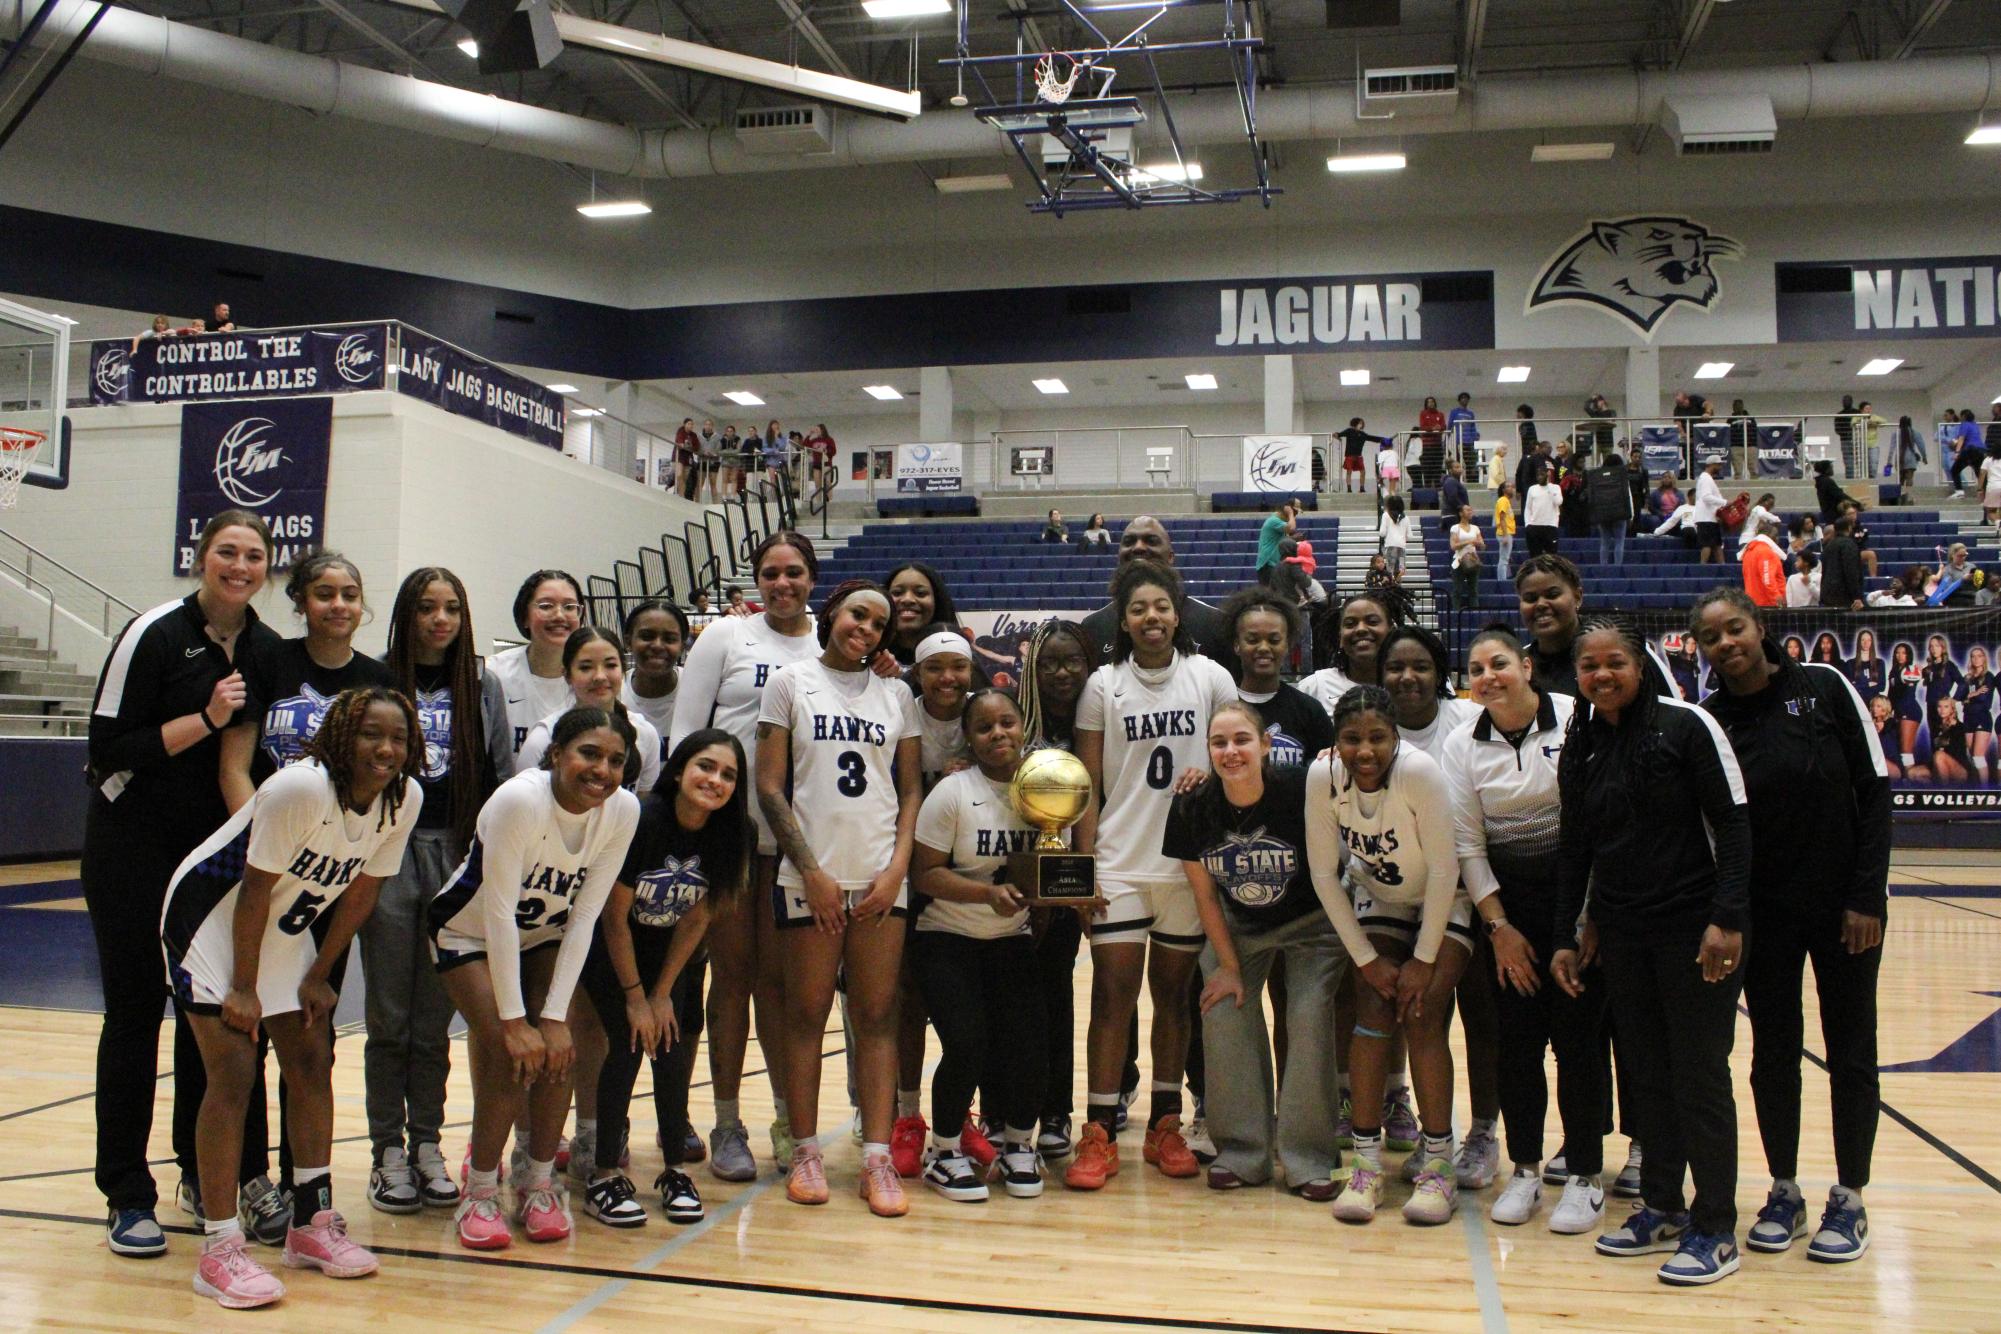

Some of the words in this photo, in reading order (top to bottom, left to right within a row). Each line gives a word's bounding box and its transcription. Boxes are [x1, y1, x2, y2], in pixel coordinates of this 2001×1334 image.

[1854, 266, 2001, 329] NATI
[1215, 283, 1421, 346] JAGUAR
[156, 340, 247, 364] CONTROL
[258, 336, 301, 358] THE
[145, 367, 317, 396] CONTROLLABLES
[400, 347, 440, 384] LADY
[446, 369, 482, 401] JAGS
[487, 383, 563, 433] BASKETBALL
[1758, 449, 1794, 459] ATTACK
[265, 709, 298, 736] UIL
[814, 714, 886, 747] HAWKS
[1124, 710, 1196, 742] HAWKS
[1146, 745, 1174, 789] 0
[1268, 746, 1304, 768] TATE
[837, 751, 868, 797] 3
[1893, 794, 1915, 806] GS
[976, 829, 1040, 856] HAWK
[288, 848, 367, 887] HAWK
[1236, 849, 1296, 874] STATE
